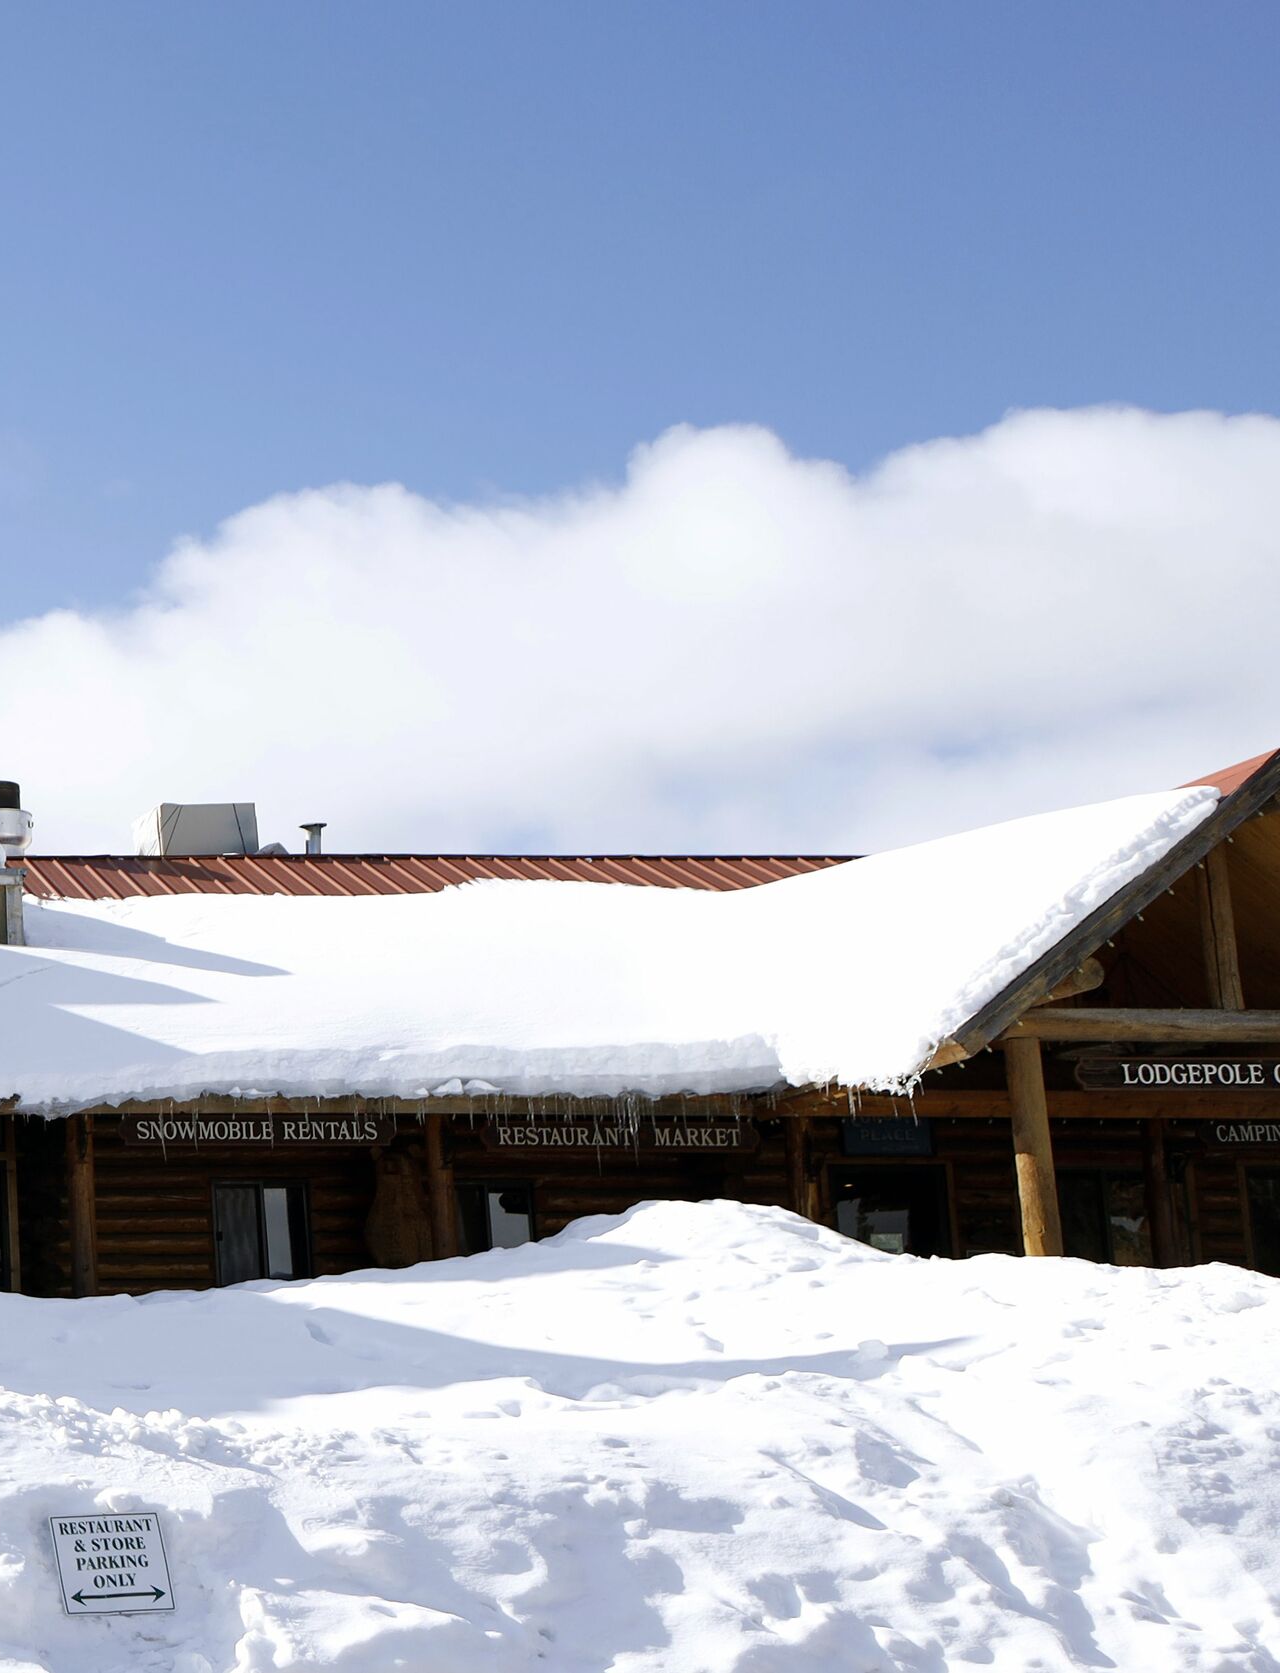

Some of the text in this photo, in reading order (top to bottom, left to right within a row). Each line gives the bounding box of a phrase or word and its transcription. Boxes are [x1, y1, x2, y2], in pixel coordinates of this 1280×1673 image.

[1121, 1063, 1265, 1085] LODGEPOLE
[136, 1121, 378, 1141] SNOWMOBILE RENTALS
[498, 1127, 741, 1147] RESTAURANT MARKET
[59, 1519, 152, 1536] RESTAURANT
[74, 1537, 146, 1552] & STORE
[76, 1554, 149, 1571] PARKING
[93, 1573, 137, 1589] ONLY
